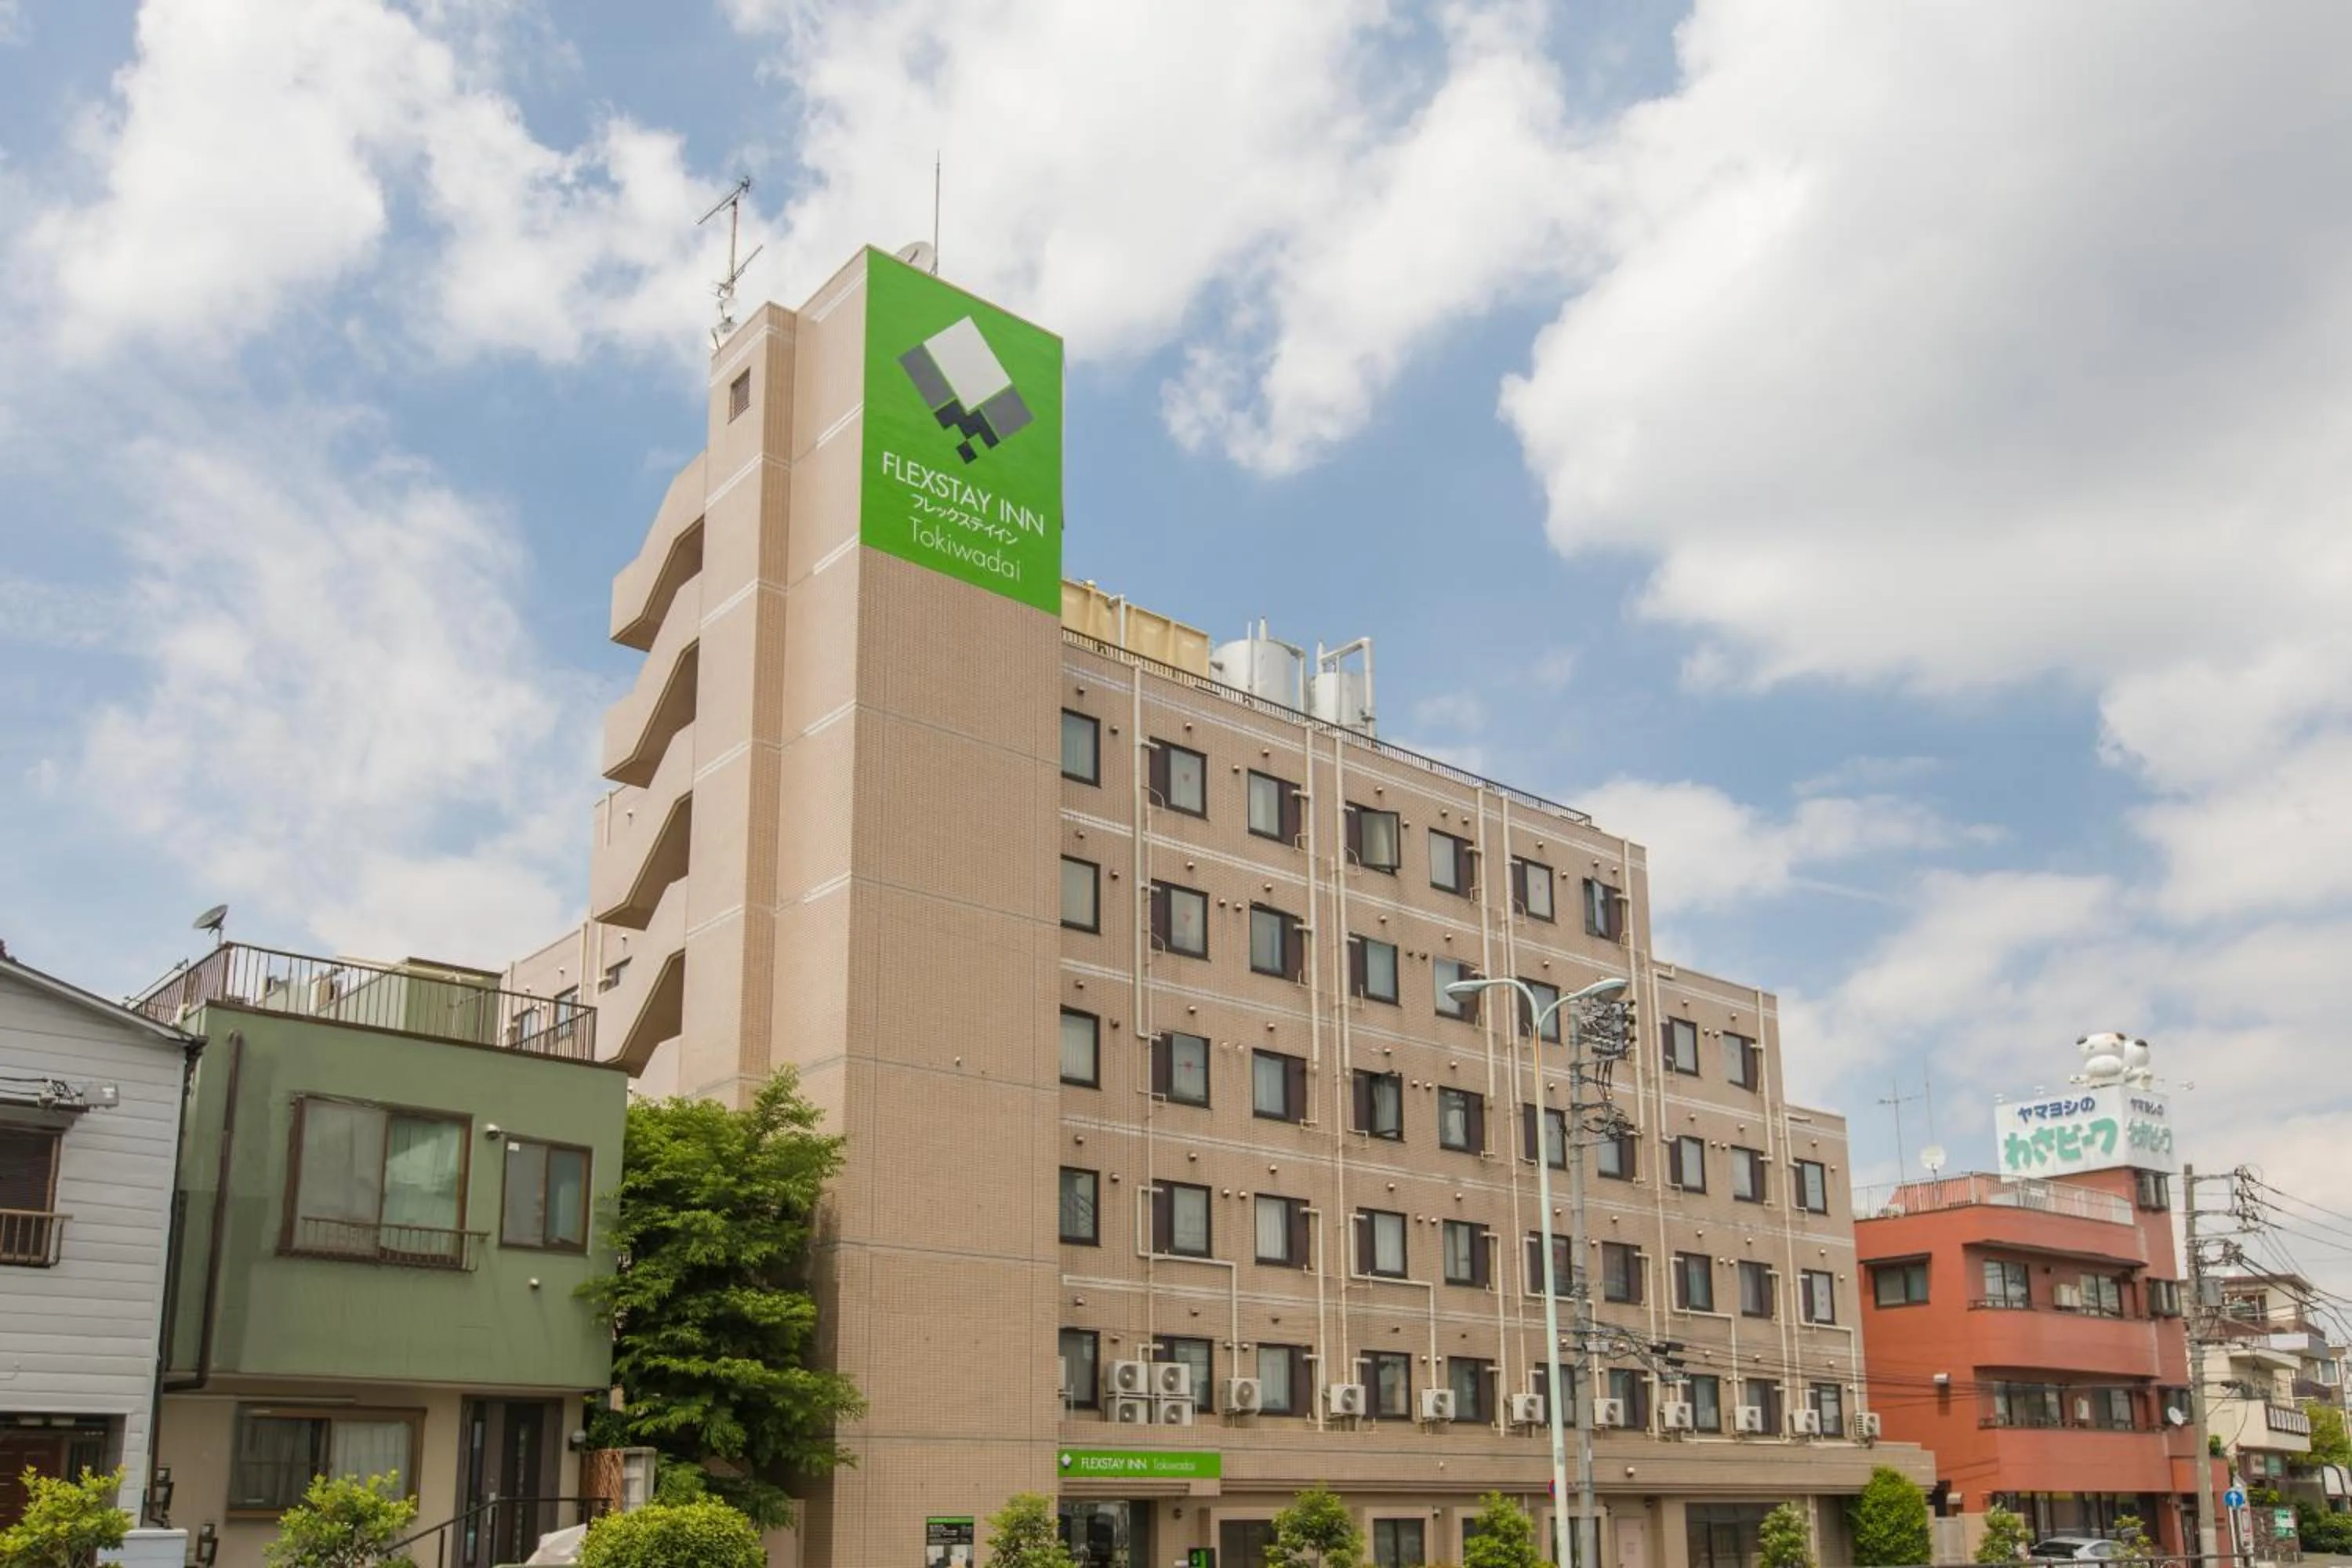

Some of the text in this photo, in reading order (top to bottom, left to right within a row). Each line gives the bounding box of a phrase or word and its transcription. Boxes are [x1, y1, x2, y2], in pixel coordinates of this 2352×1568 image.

[883, 451, 1045, 538] FLEXSTAY INN
[909, 516, 1022, 583] Tokiwadai
[2017, 1096, 2096, 1123] ヤマヨシの
[2004, 1117, 2118, 1170] わさビーフ
[1081, 1457, 1124, 1470] FLEXSTAY
[1127, 1457, 1147, 1471] INN
